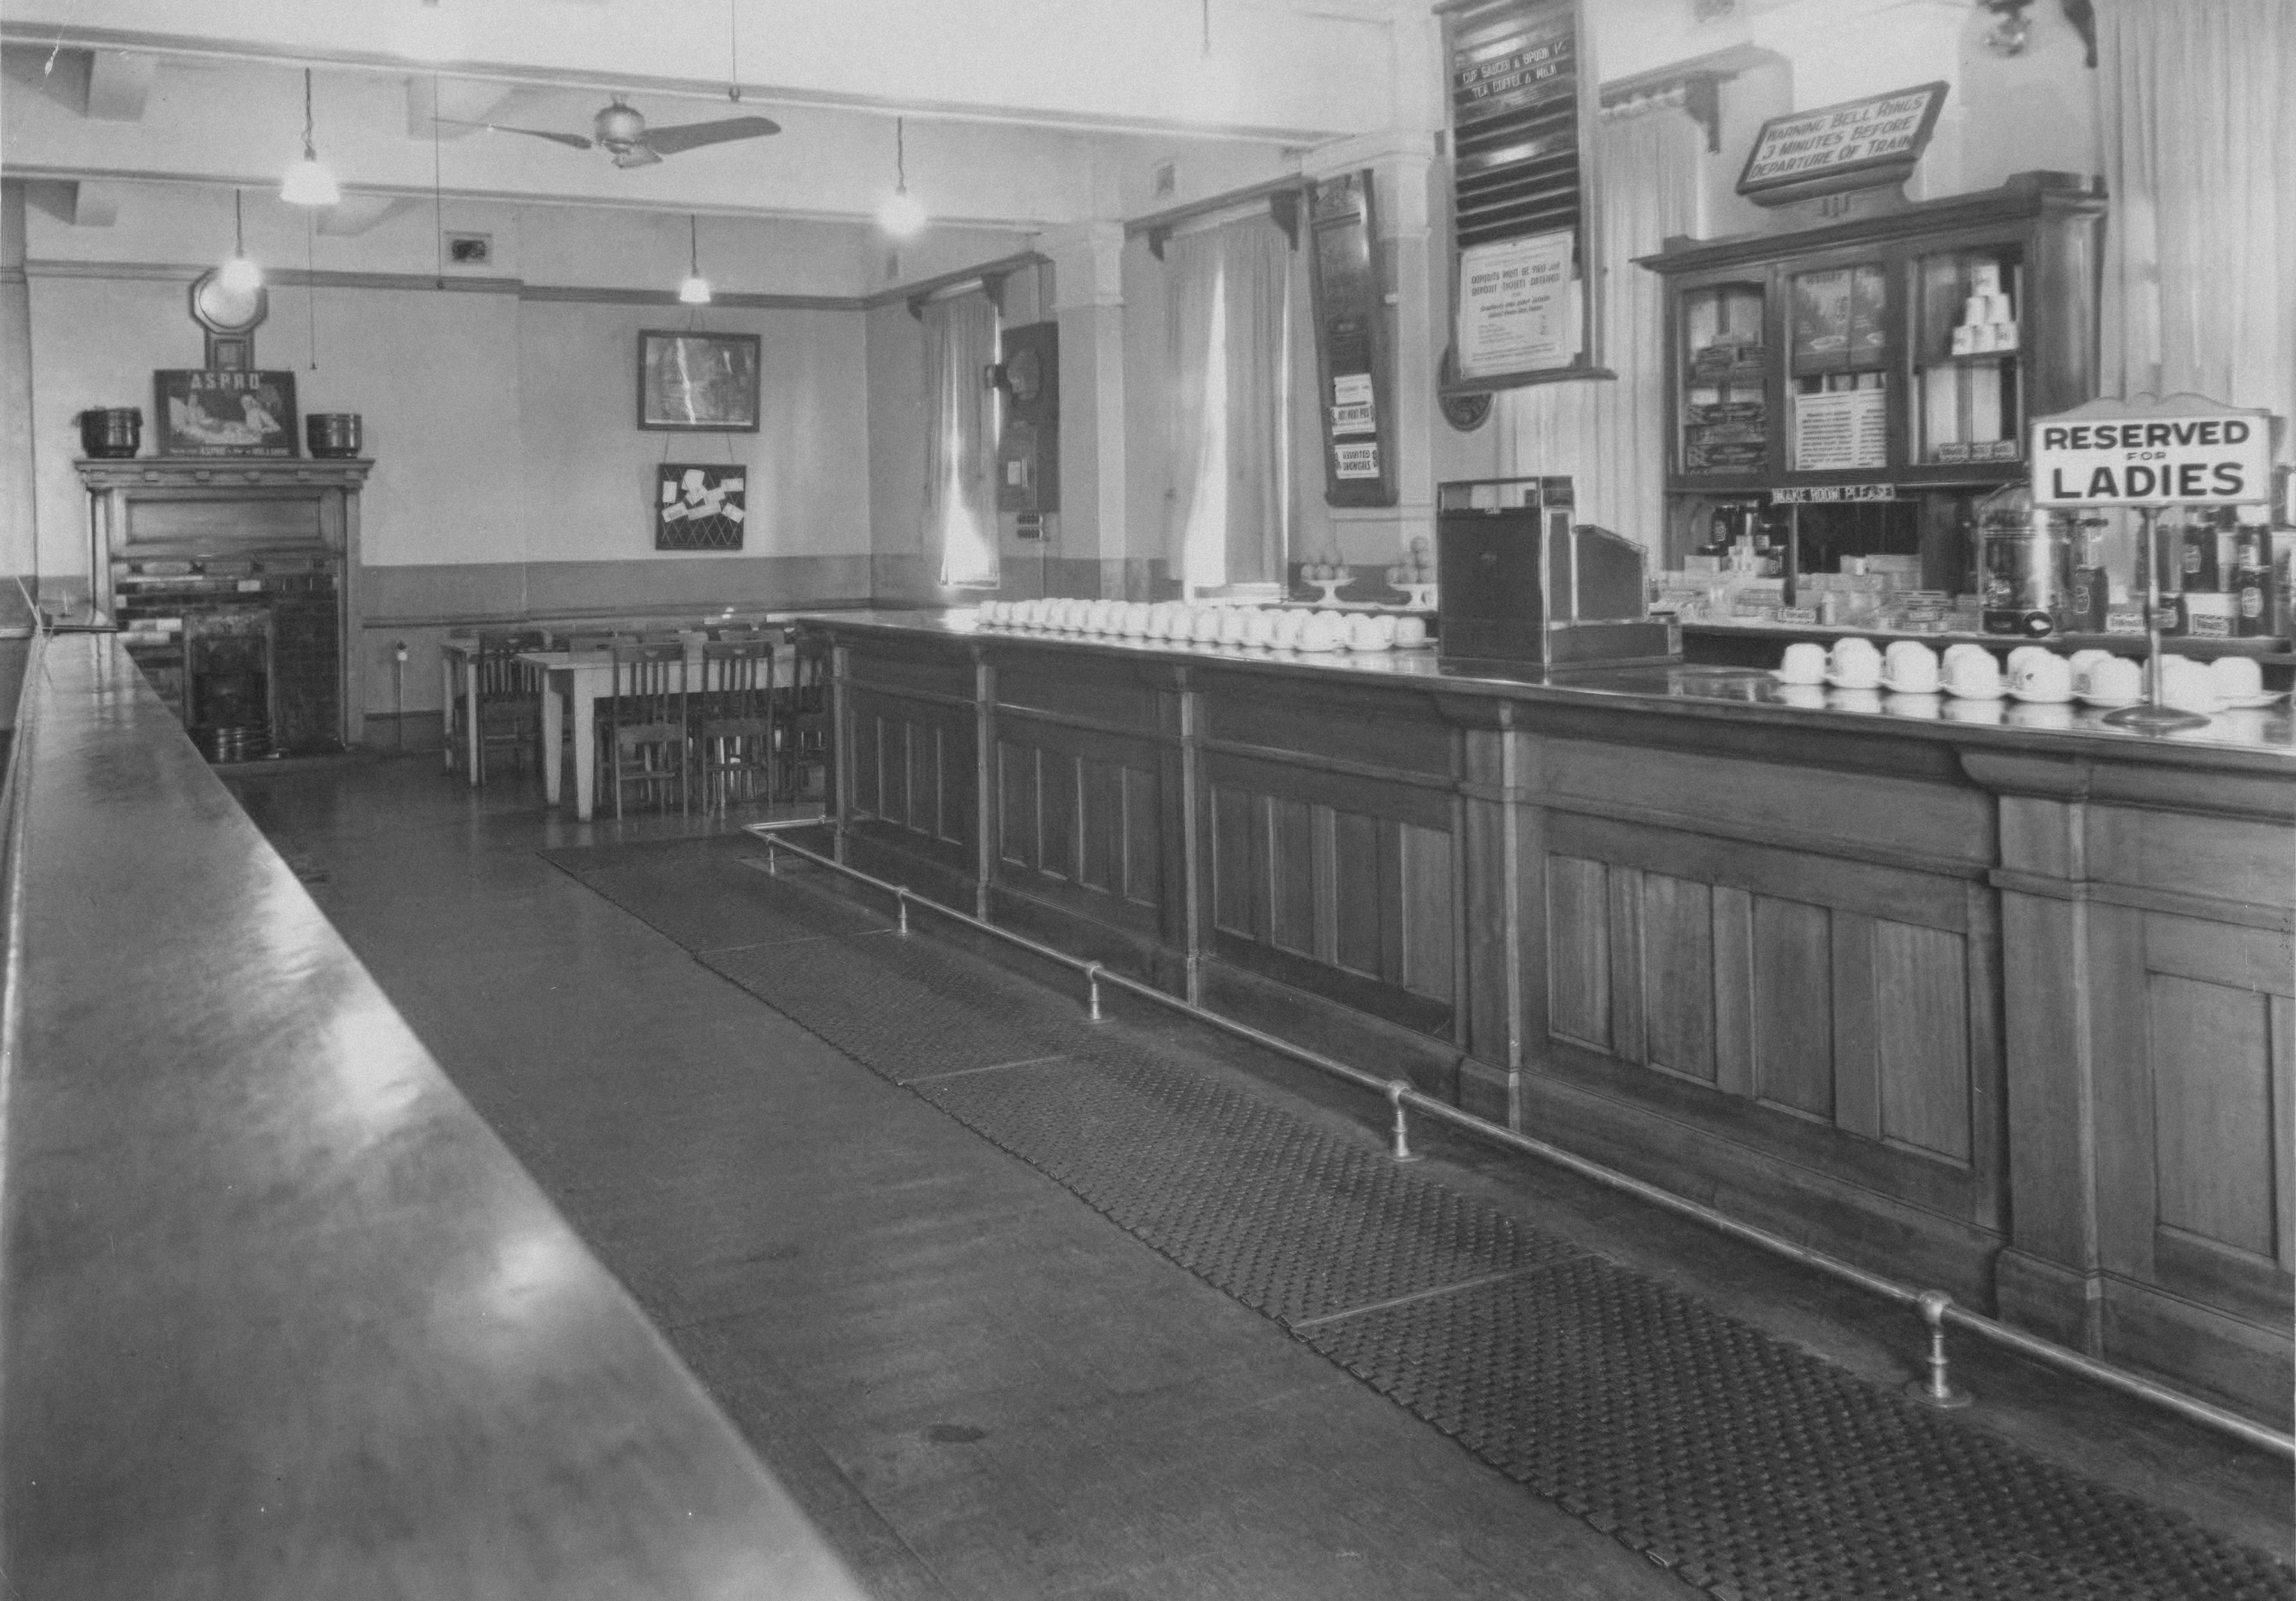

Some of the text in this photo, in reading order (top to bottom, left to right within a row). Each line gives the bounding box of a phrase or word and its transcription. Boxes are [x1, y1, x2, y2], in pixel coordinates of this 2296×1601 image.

[1767, 97, 1923, 142] WARNING BELL RINGS
[1750, 135, 1913, 178] DEPARTURE OF TRAIN
[1762, 116, 1914, 161] 3 MINUTES BEFORE
[191, 373, 260, 389] ASPRO
[2044, 421, 2250, 451] RESERVED
[2126, 452, 2167, 461] FOR
[2053, 462, 2244, 498] LADIES
